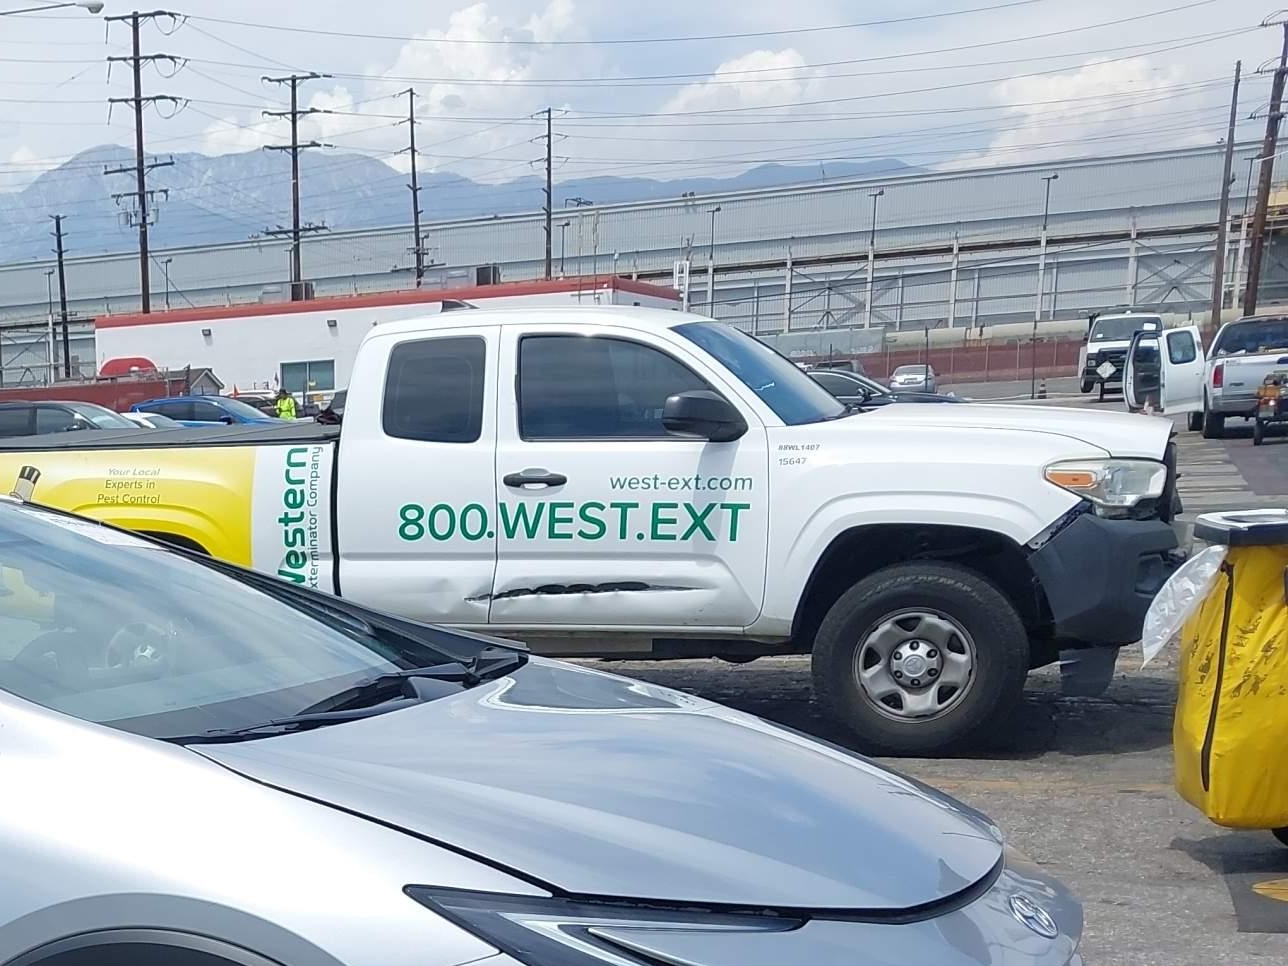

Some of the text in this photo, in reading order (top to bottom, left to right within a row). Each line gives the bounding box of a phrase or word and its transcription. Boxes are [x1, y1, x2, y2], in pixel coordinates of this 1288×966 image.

[108, 468, 160, 476] Your Local
[105, 480, 156, 491] Experts in
[610, 474, 754, 491] west-ext.com
[97, 493, 161, 504] Pest Control
[307, 446, 323, 589] xterminator Company
[398, 501, 751, 542] 800.WEST.EXT
